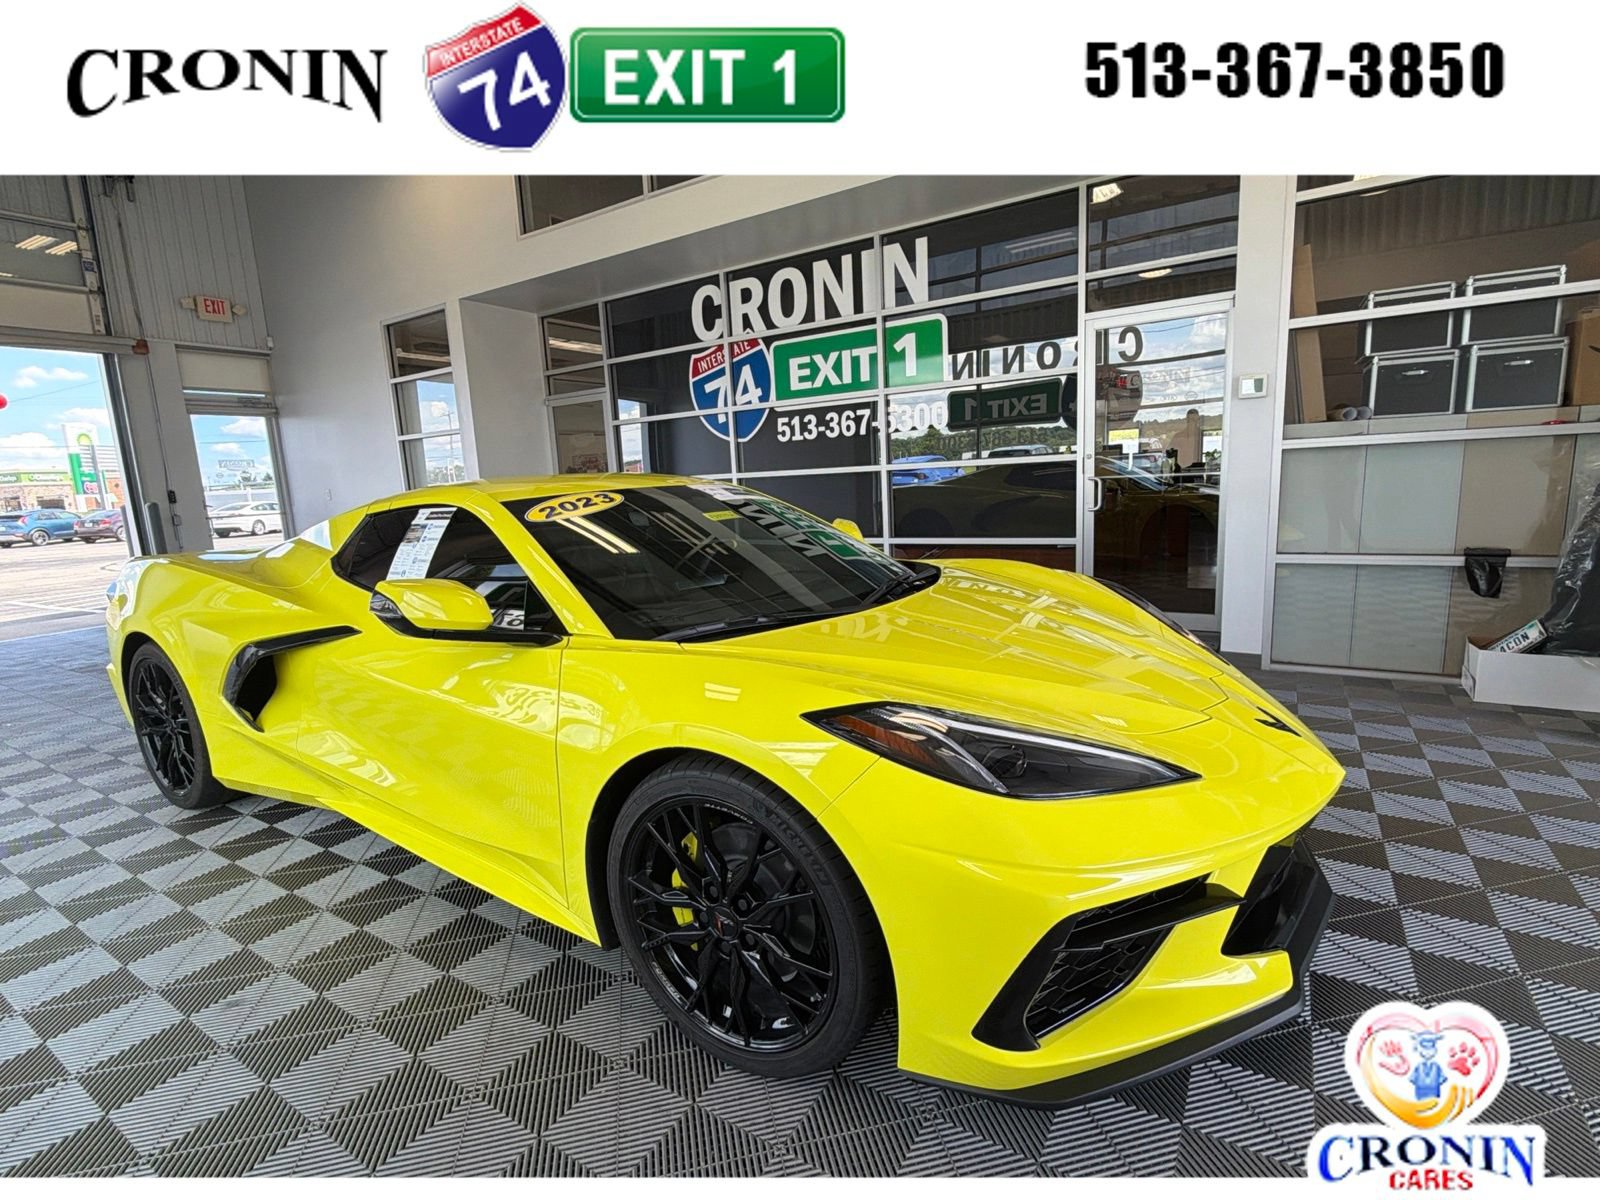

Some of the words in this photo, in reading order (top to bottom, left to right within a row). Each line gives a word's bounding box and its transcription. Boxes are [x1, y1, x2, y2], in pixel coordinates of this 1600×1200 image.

[203, 297, 226, 315] EXIT
[691, 236, 929, 341] CRONIN
[788, 345, 878, 391] EXIT
[893, 332, 917, 377] 1
[704, 364, 763, 424] 74
[538, 493, 617, 519] 2023
